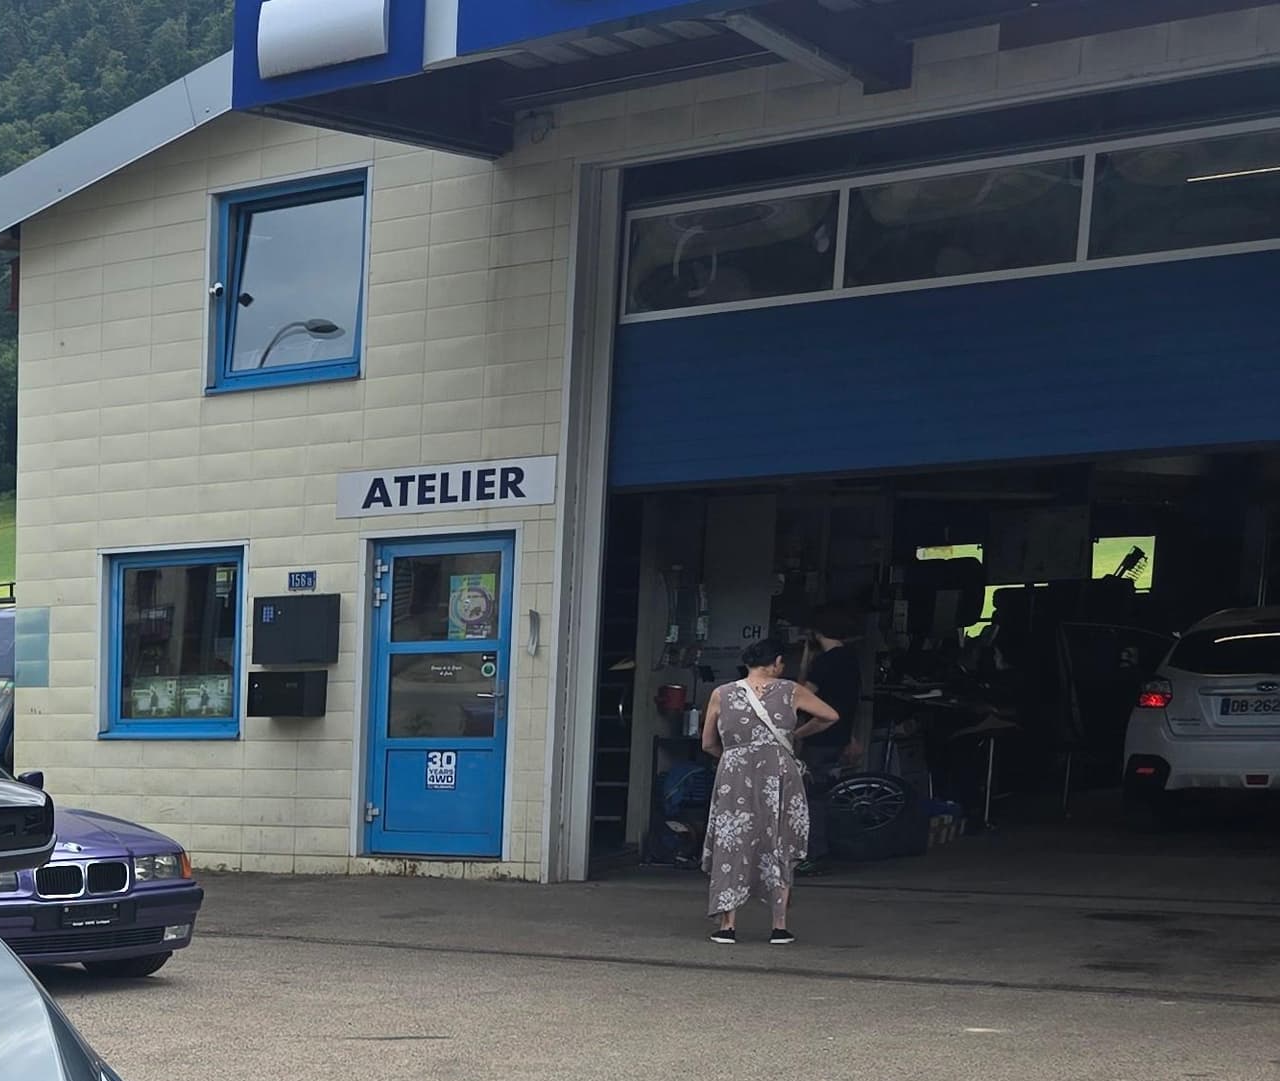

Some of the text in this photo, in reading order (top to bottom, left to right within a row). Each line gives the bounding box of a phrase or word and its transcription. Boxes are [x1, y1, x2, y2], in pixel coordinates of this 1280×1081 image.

[361, 466, 527, 510] ATELIER
[428, 751, 456, 768] 30
[429, 775, 454, 783] 4WD
